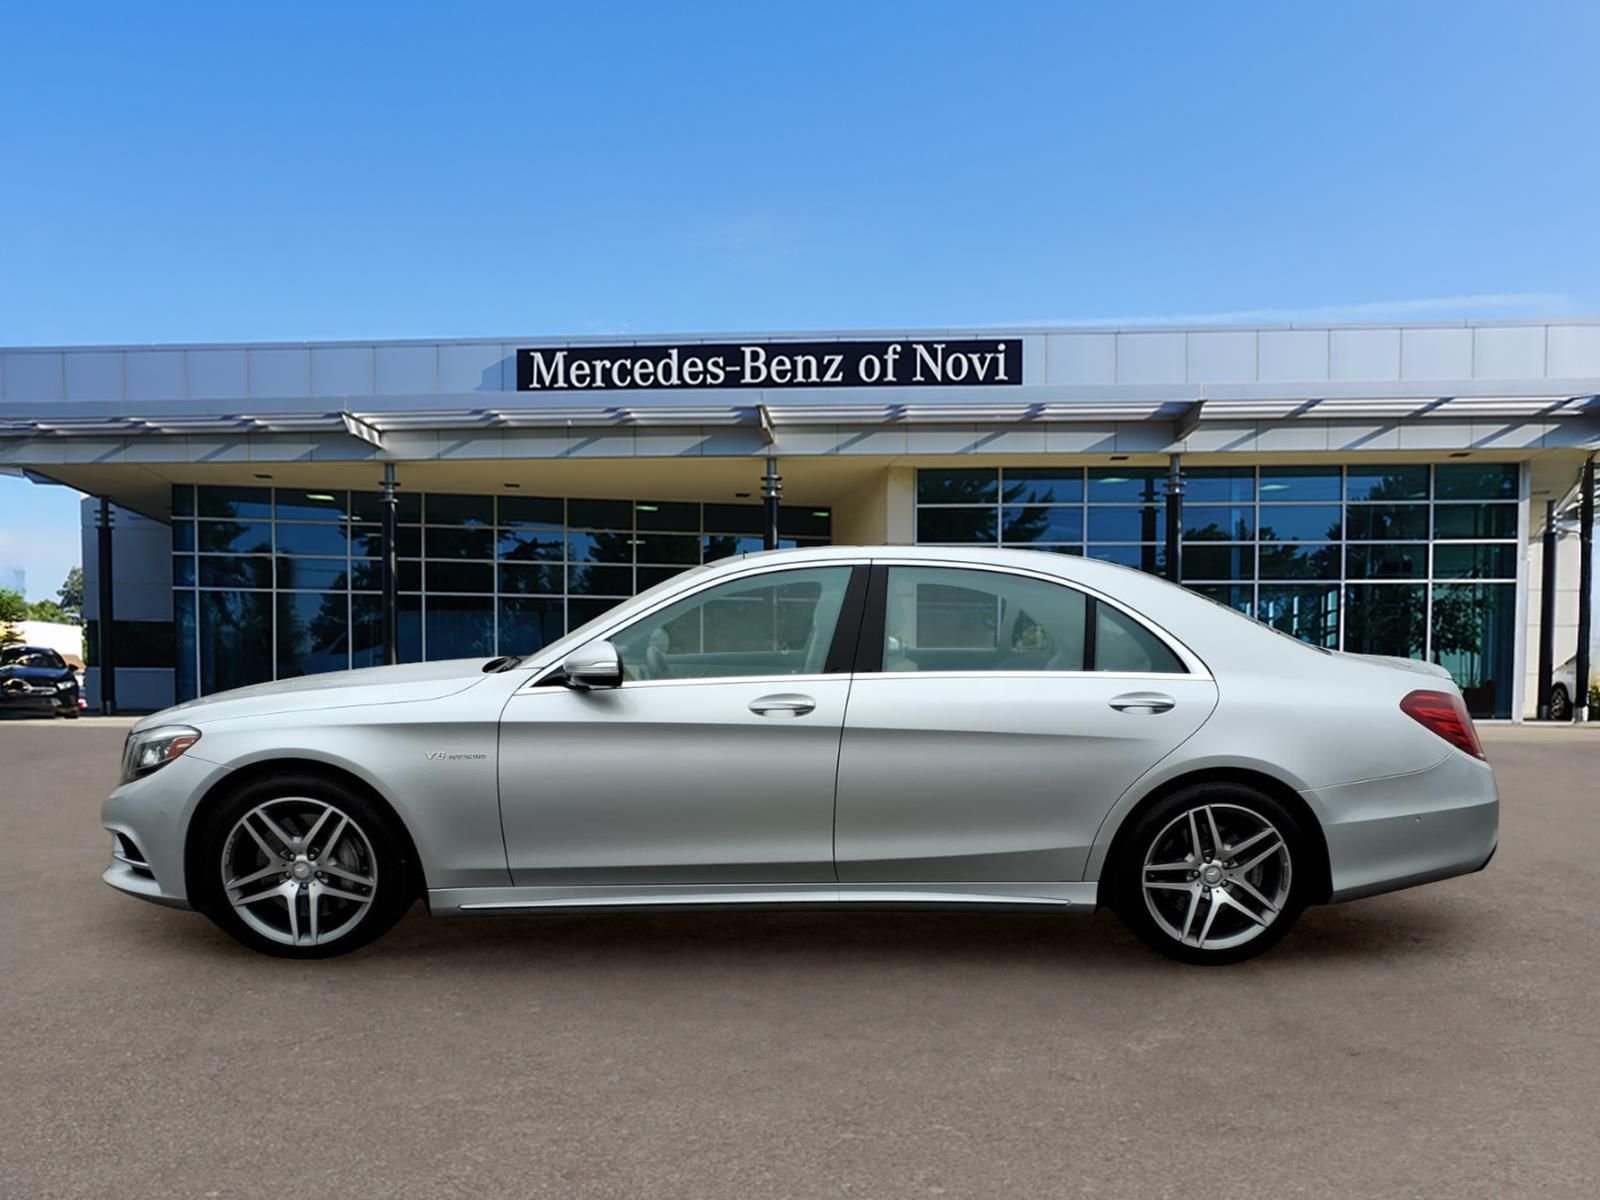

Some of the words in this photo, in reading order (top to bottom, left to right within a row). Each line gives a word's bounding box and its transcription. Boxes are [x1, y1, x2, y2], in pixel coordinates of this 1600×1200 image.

[529, 345, 843, 389] Mercedes-Benz
[858, 344, 902, 384] of
[912, 343, 1009, 382] Novi
